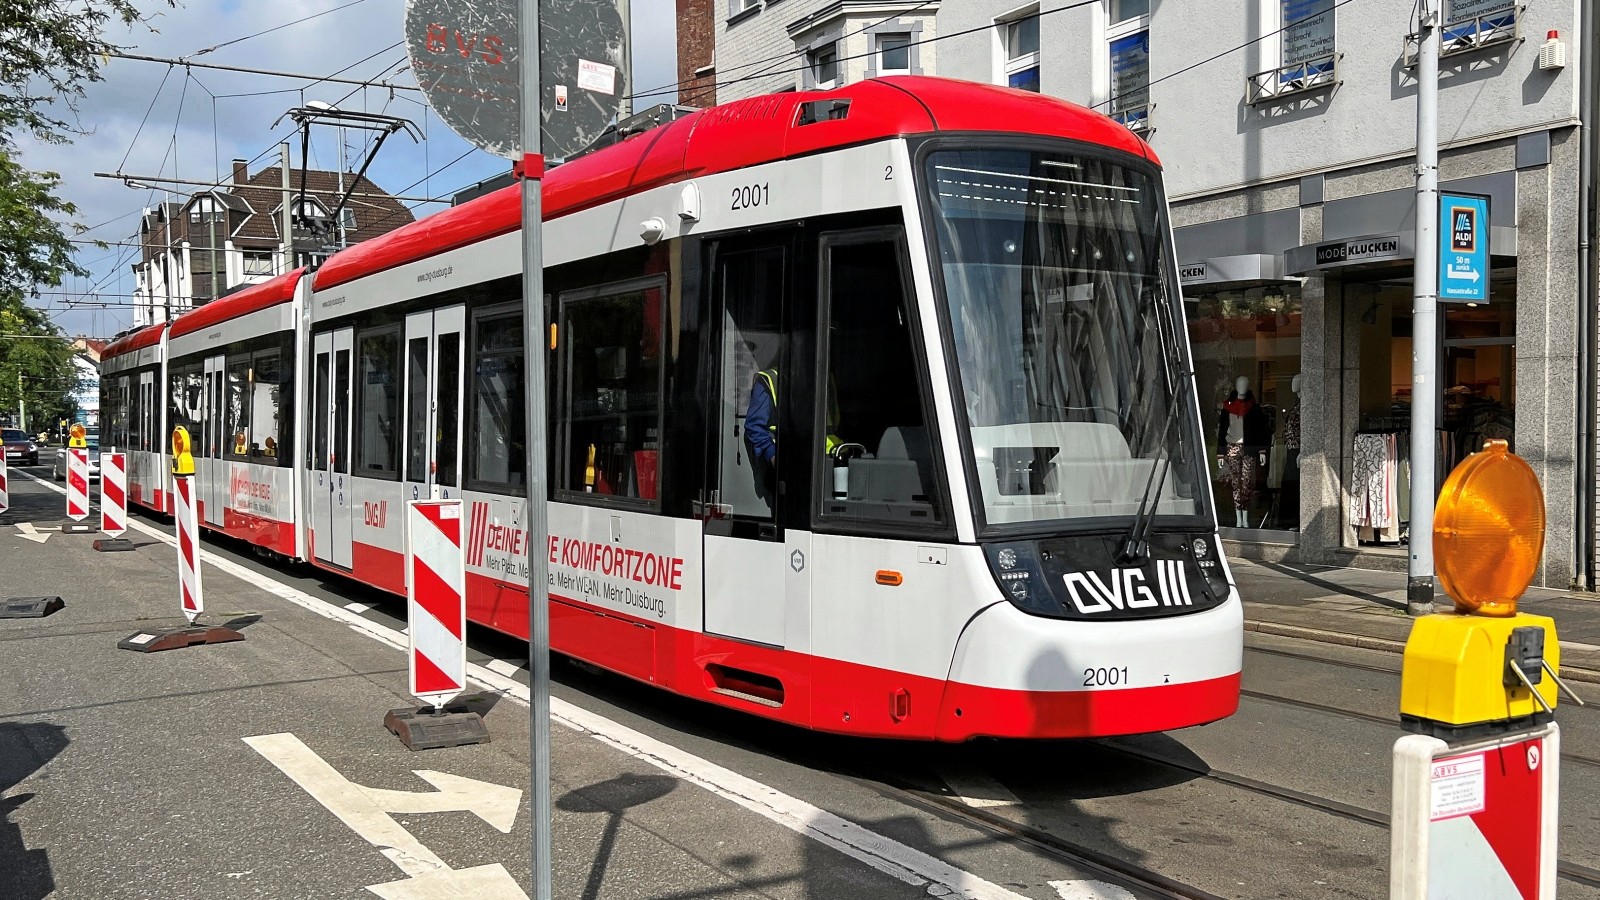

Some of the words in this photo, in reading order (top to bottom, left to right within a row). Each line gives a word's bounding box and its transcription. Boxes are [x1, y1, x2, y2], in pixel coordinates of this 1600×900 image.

[884, 165, 893, 181] 2
[731, 182, 770, 211] 2001
[1455, 232, 1472, 241] ALDI
[1318, 247, 1345, 260] MODE
[1348, 241, 1397, 256] KLUCKEN
[1456, 256, 1463, 264] 50
[486, 524, 521, 555] DEINE
[561, 538, 684, 591] KOMFORTZONE
[557, 571, 575, 591] Mehr
[603, 582, 623, 603] Mehr
[625, 588, 667, 618] Duisburg.
[1083, 666, 1128, 686] 2001
